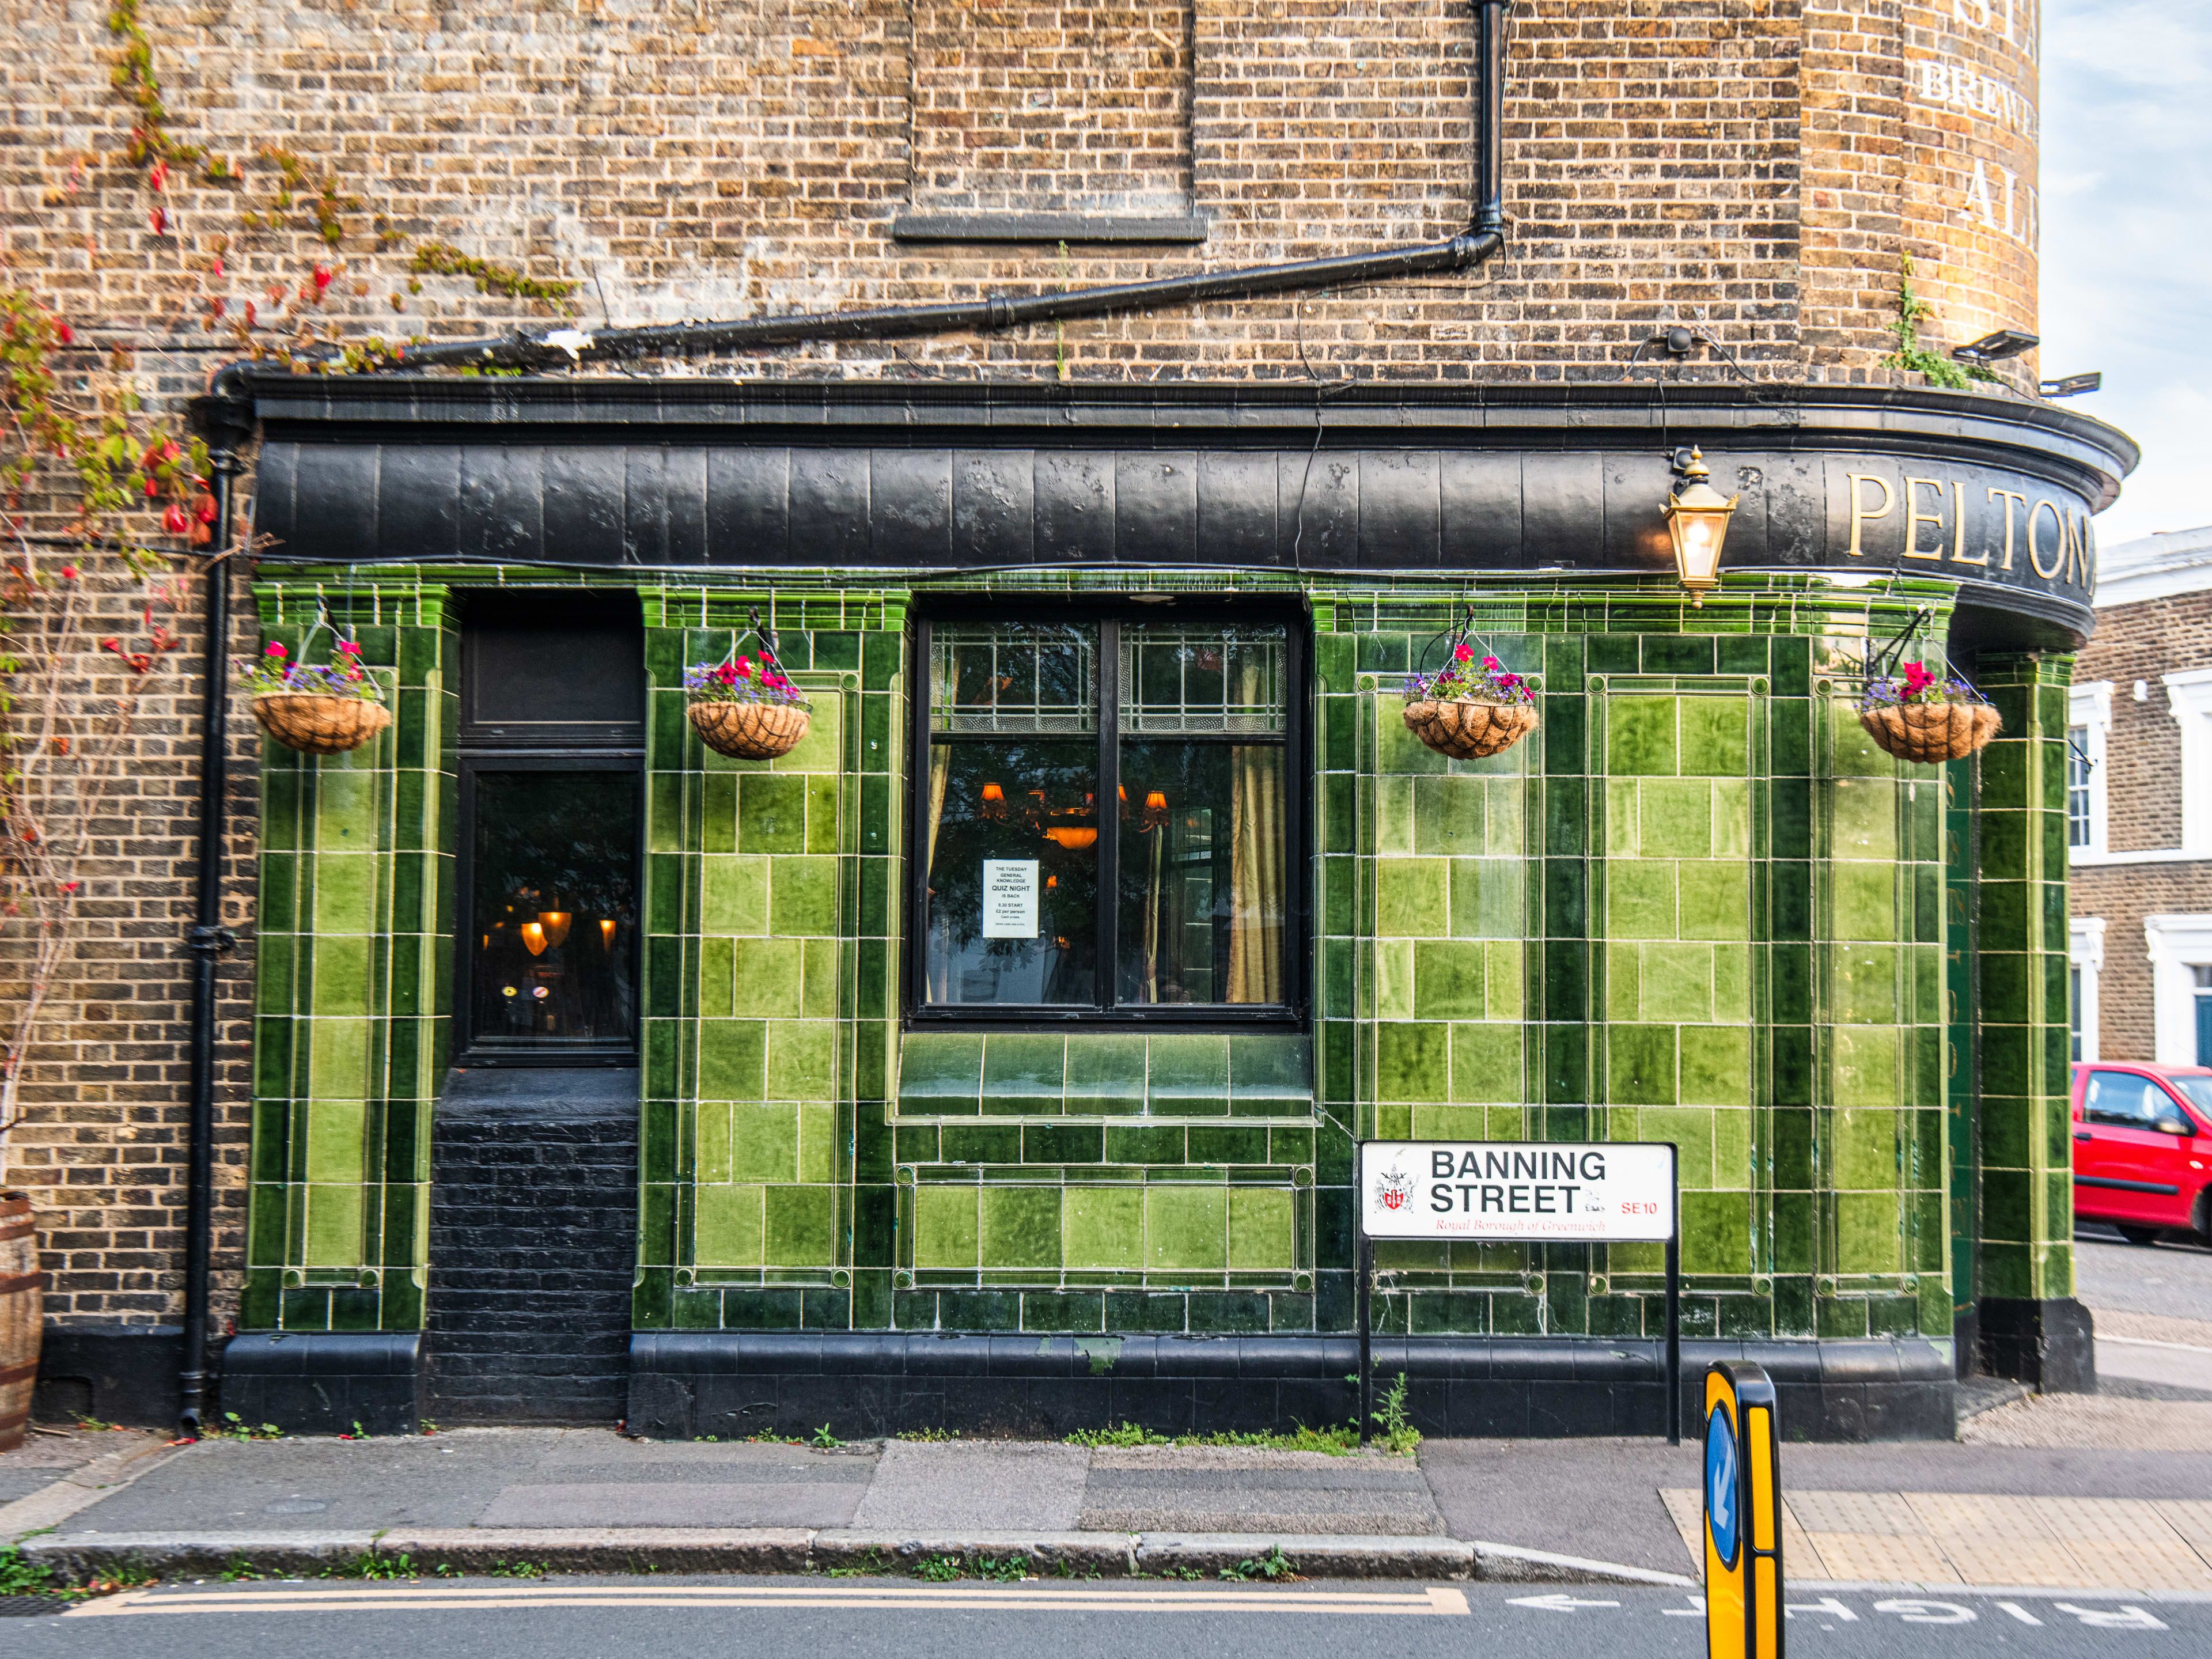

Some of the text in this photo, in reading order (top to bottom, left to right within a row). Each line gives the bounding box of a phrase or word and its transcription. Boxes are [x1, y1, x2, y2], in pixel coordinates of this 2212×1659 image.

[1847, 473, 2089, 588] PELTON
[1431, 1150, 1605, 1180] BANNING
[1430, 1183, 1657, 1215] STREET SE10
[1436, 1219, 1606, 1233] Royal Borough of Greenwich
